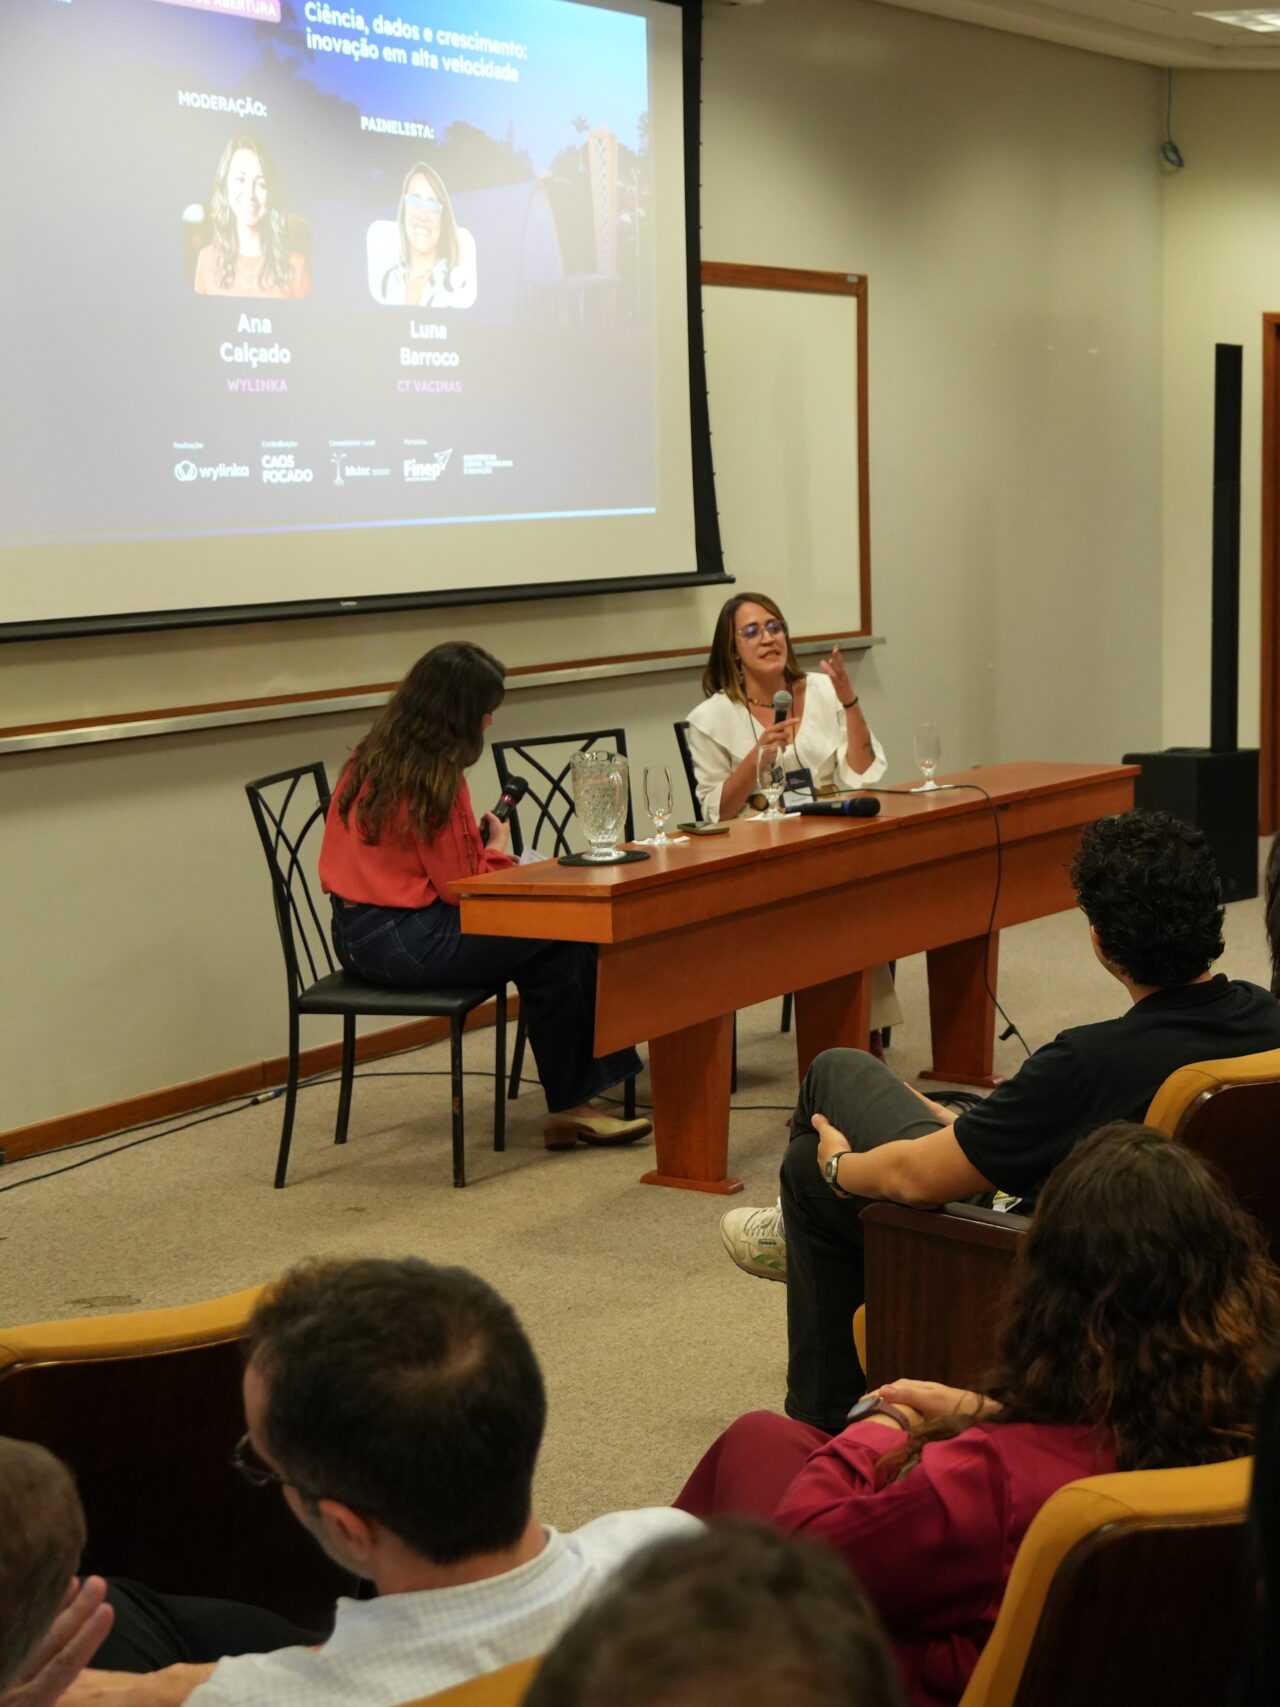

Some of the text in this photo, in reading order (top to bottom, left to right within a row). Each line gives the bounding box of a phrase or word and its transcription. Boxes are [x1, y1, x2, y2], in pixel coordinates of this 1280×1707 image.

[304, 1, 528, 60] Ciência, dados e crescimento:
[306, 27, 519, 83] inovação em alta velocidade
[178, 90, 268, 118] MODERAÇÃO:
[360, 115, 435, 140] PAINELISTA:
[237, 313, 273, 334] Ana
[410, 320, 448, 340] Luna
[220, 342, 291, 368] Calçado
[400, 347, 460, 367] Barroco
[227, 378, 289, 392] WYLINKA
[397, 380, 462, 393] CT VACINAS
[199, 462, 250, 481] wylinka
[262, 455, 295, 469] CAOS
[403, 458, 442, 481] Finep
[262, 469, 313, 484] FOCADO
